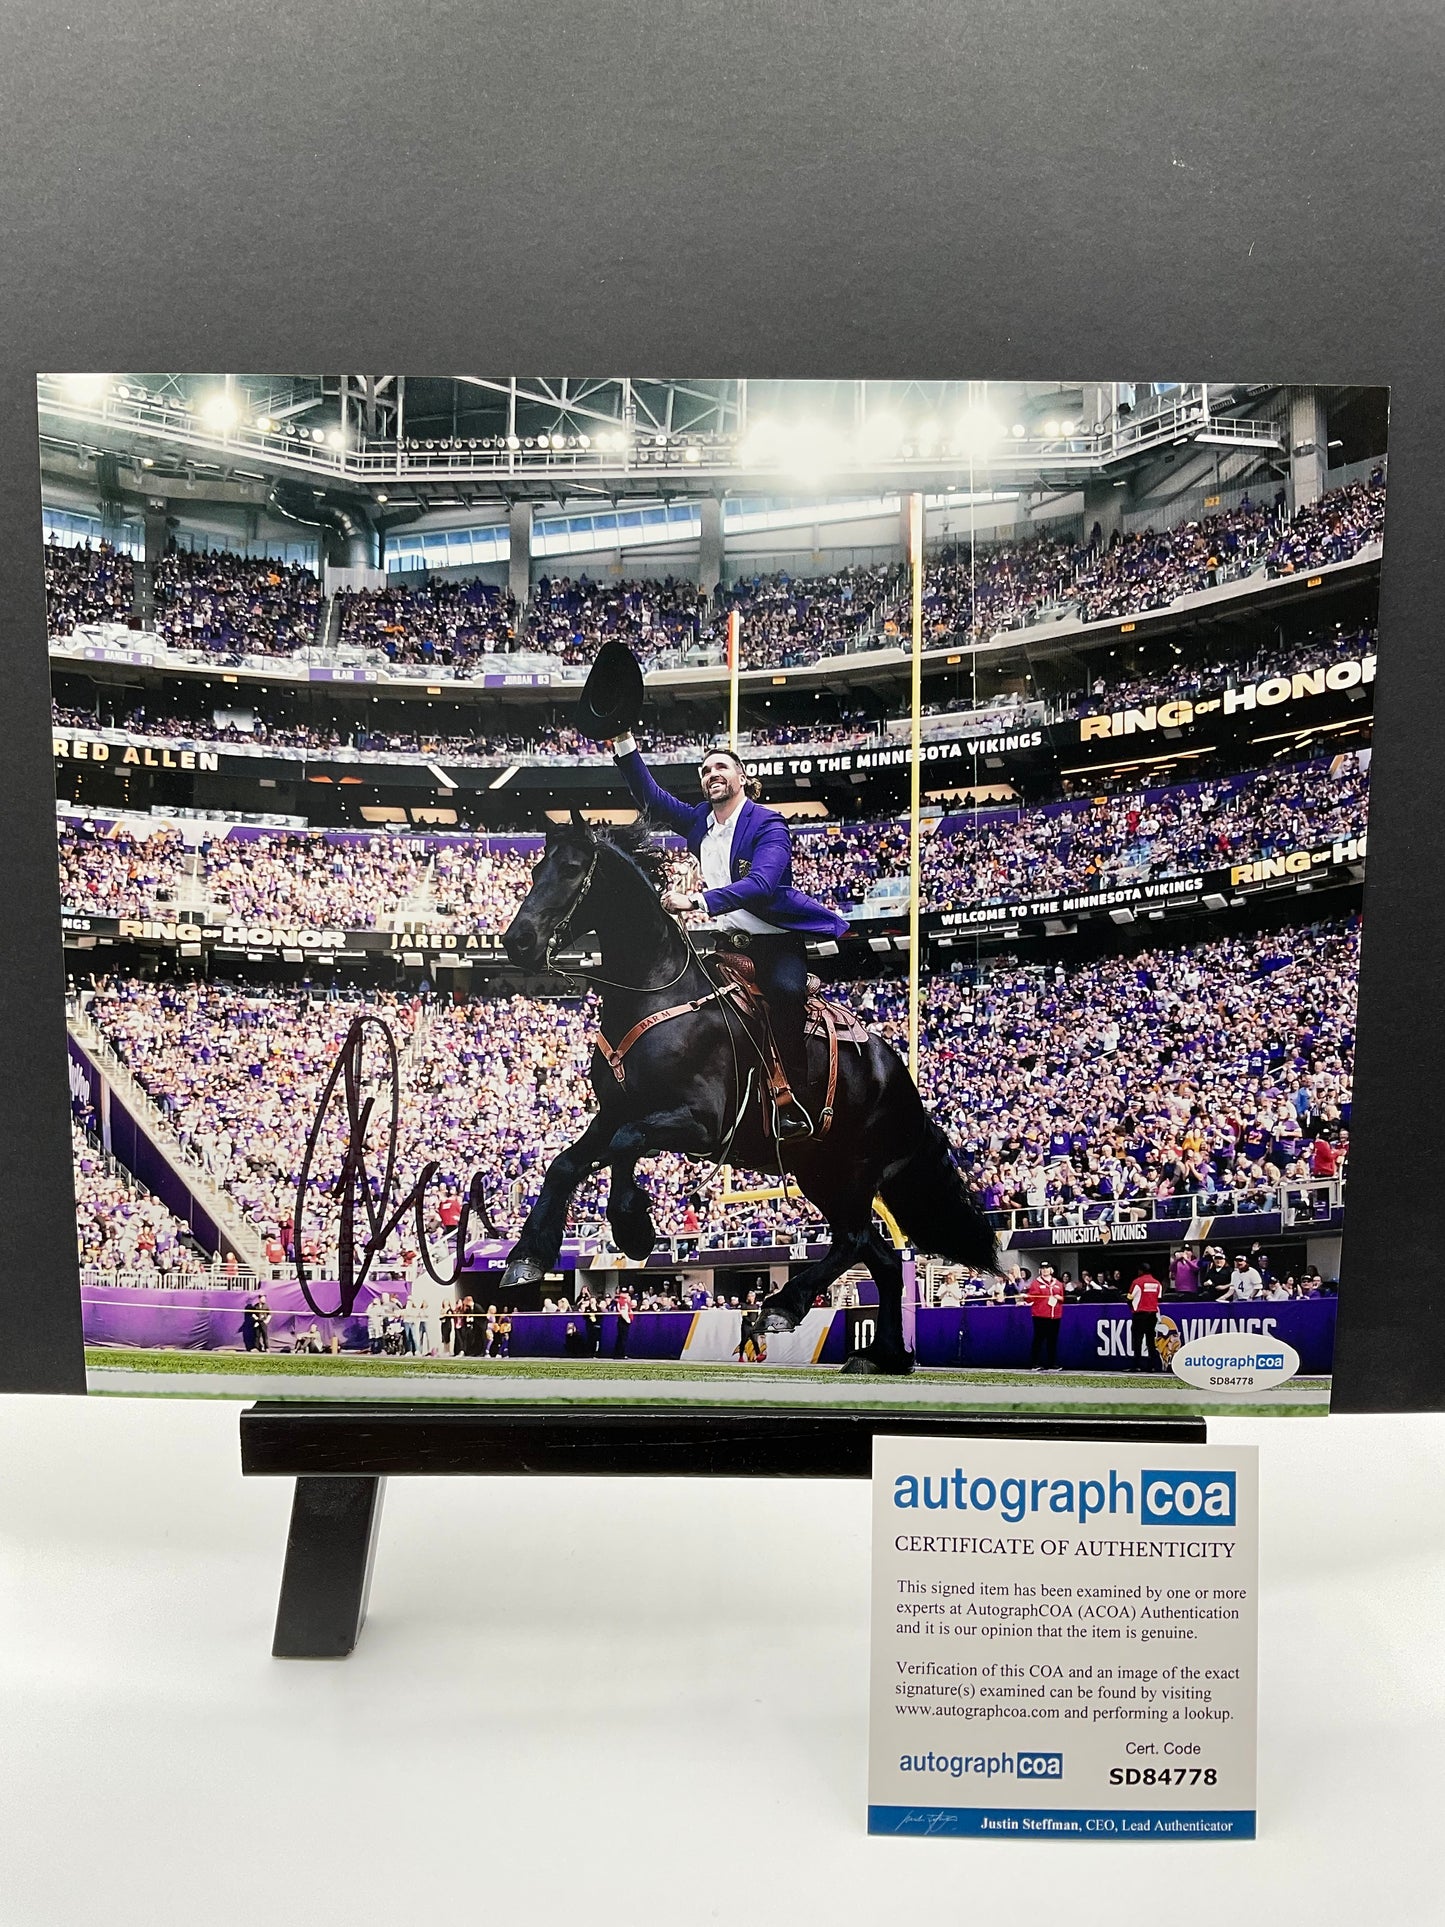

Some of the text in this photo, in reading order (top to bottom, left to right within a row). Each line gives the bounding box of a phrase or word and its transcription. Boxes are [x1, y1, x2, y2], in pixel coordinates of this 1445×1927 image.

[1080, 700, 1194, 741] RING
[53, 738, 218, 771] RED ALLEN
[789, 760, 812, 774] TO
[817, 756, 852, 772] THE
[856, 743, 961, 769] MINNESOTA
[967, 731, 1042, 756] VIKINGS
[1230, 851, 1311, 886] RING
[941, 878, 1203, 926] WELCOME TO THE MINNESOTA VIKINGS
[119, 920, 202, 941] RING
[223, 926, 347, 948] HONOR
[390, 933, 458, 949] JARED
[640, 1010, 671, 1030] BAR M
[1052, 1223, 1148, 1245] MINNESOTA VIKINGS
[789, 1245, 808, 1260] SKOL
[1237, 1281, 1244, 1292] 4
[1097, 1319, 1150, 1356] SK
[1209, 1376, 1254, 1386] SD84778
[895, 1536, 1236, 1557] CERTIFICATE OF AUTHENTICITY
[896, 1579, 1247, 1602] This signed item has been examined by one or more
[896, 1602, 1239, 1621] experts at AutographCOA (ACOA) Authentication
[896, 1620, 1198, 1643] and it is our opinion that the item is genuine.
[896, 1661, 1240, 1683] Verification of this COA and an image of the exact
[895, 1681, 1212, 1703] signature(s) examined can be found by visiting
[895, 1704, 1234, 1723] www.autographcoa.com and performing a lookup.
[1125, 1741, 1201, 1755] Cert. Code
[1109, 1768, 1218, 1785] SD84778
[980, 1818, 1234, 1832] Justin Steffman, CEO, Lead Authenticator
